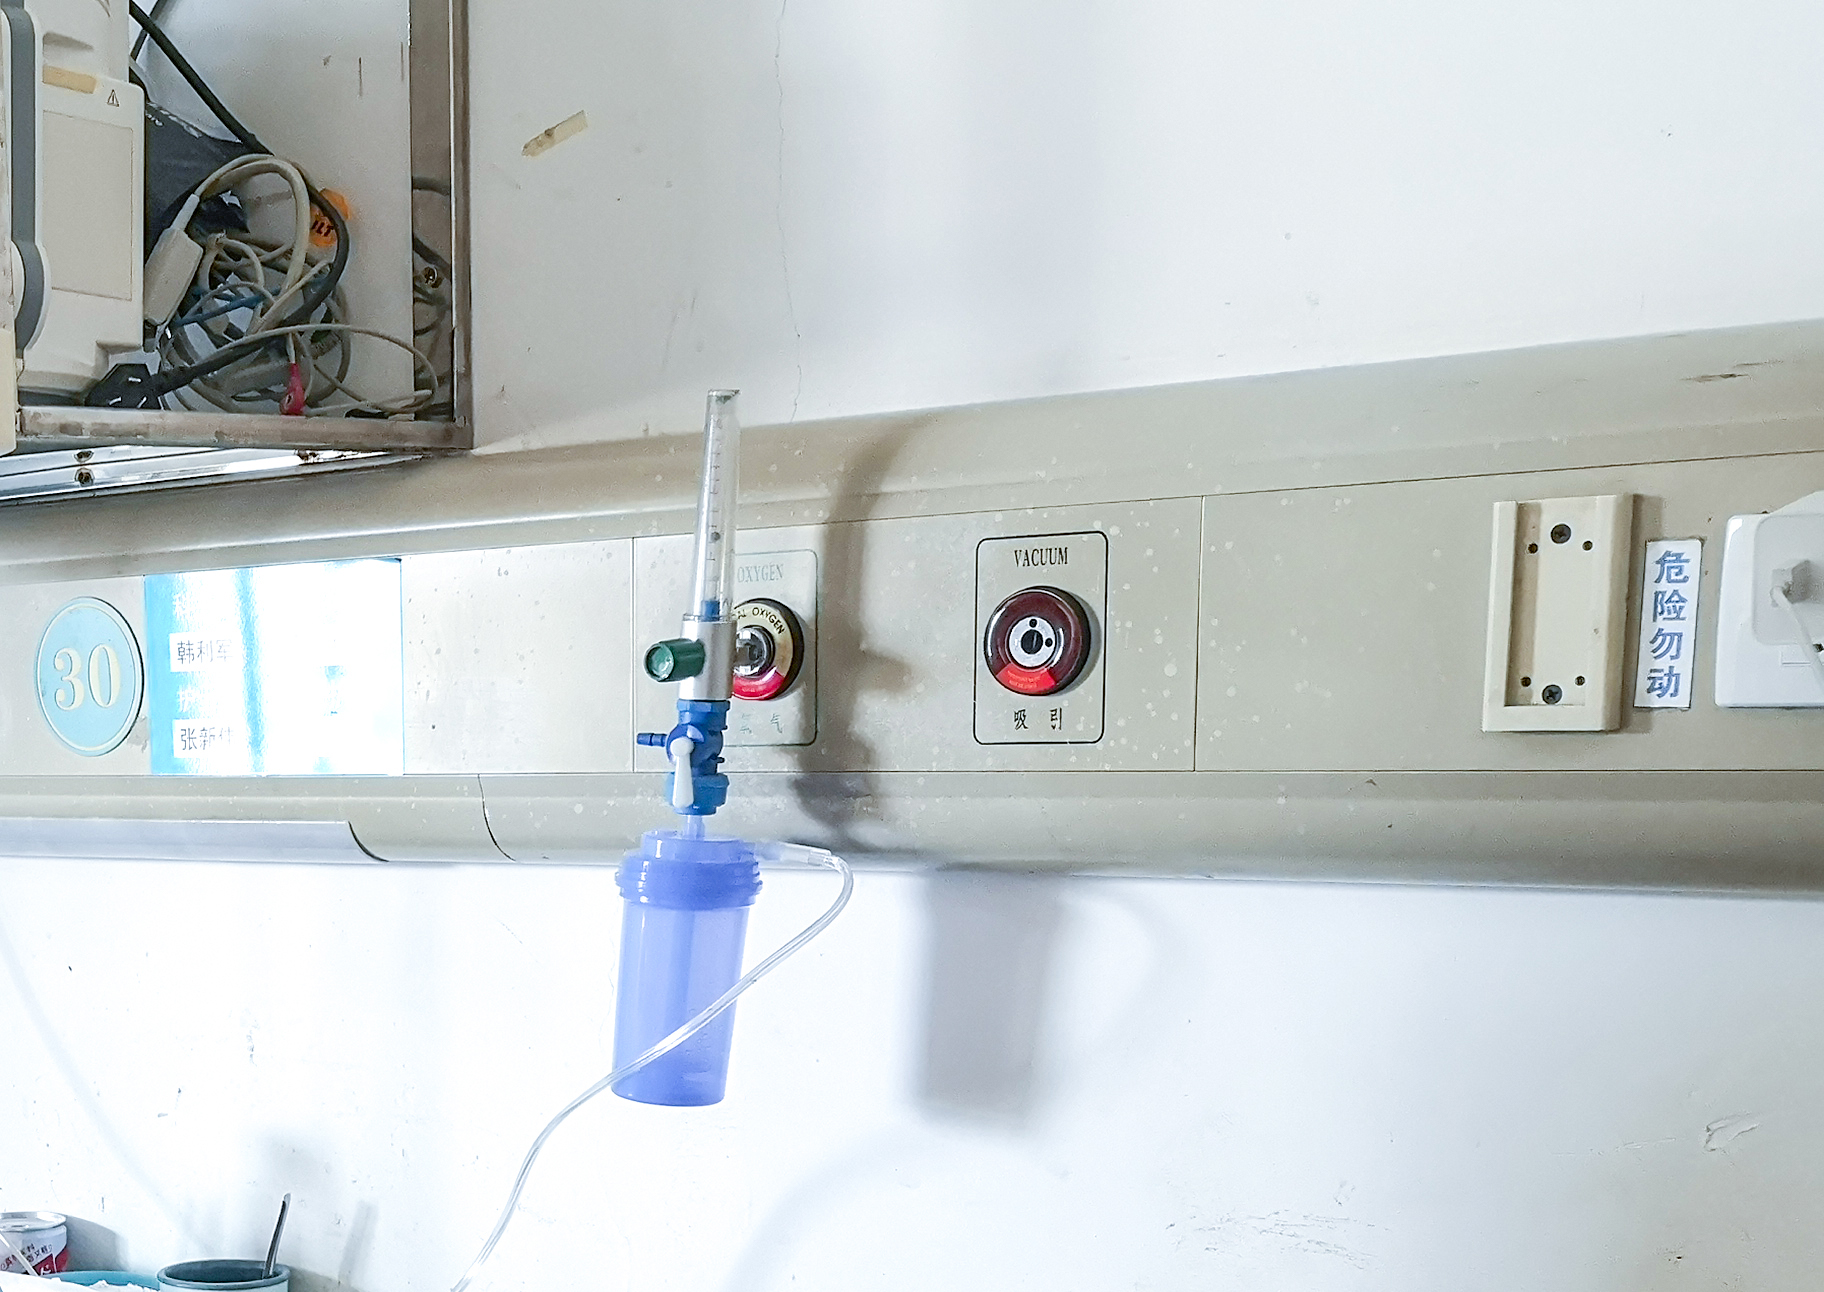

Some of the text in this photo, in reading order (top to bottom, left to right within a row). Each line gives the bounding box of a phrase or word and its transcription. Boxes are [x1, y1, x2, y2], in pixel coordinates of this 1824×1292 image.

[1014, 547, 1068, 567] VACUUM
[737, 564, 784, 583] OXYGEN
[751, 607, 786, 634] OXYGEN
[1646, 549, 1690, 700] 危险勿动
[177, 639, 234, 665] 韩利军
[53, 643, 121, 711] 30
[1013, 707, 1062, 730] 吸引
